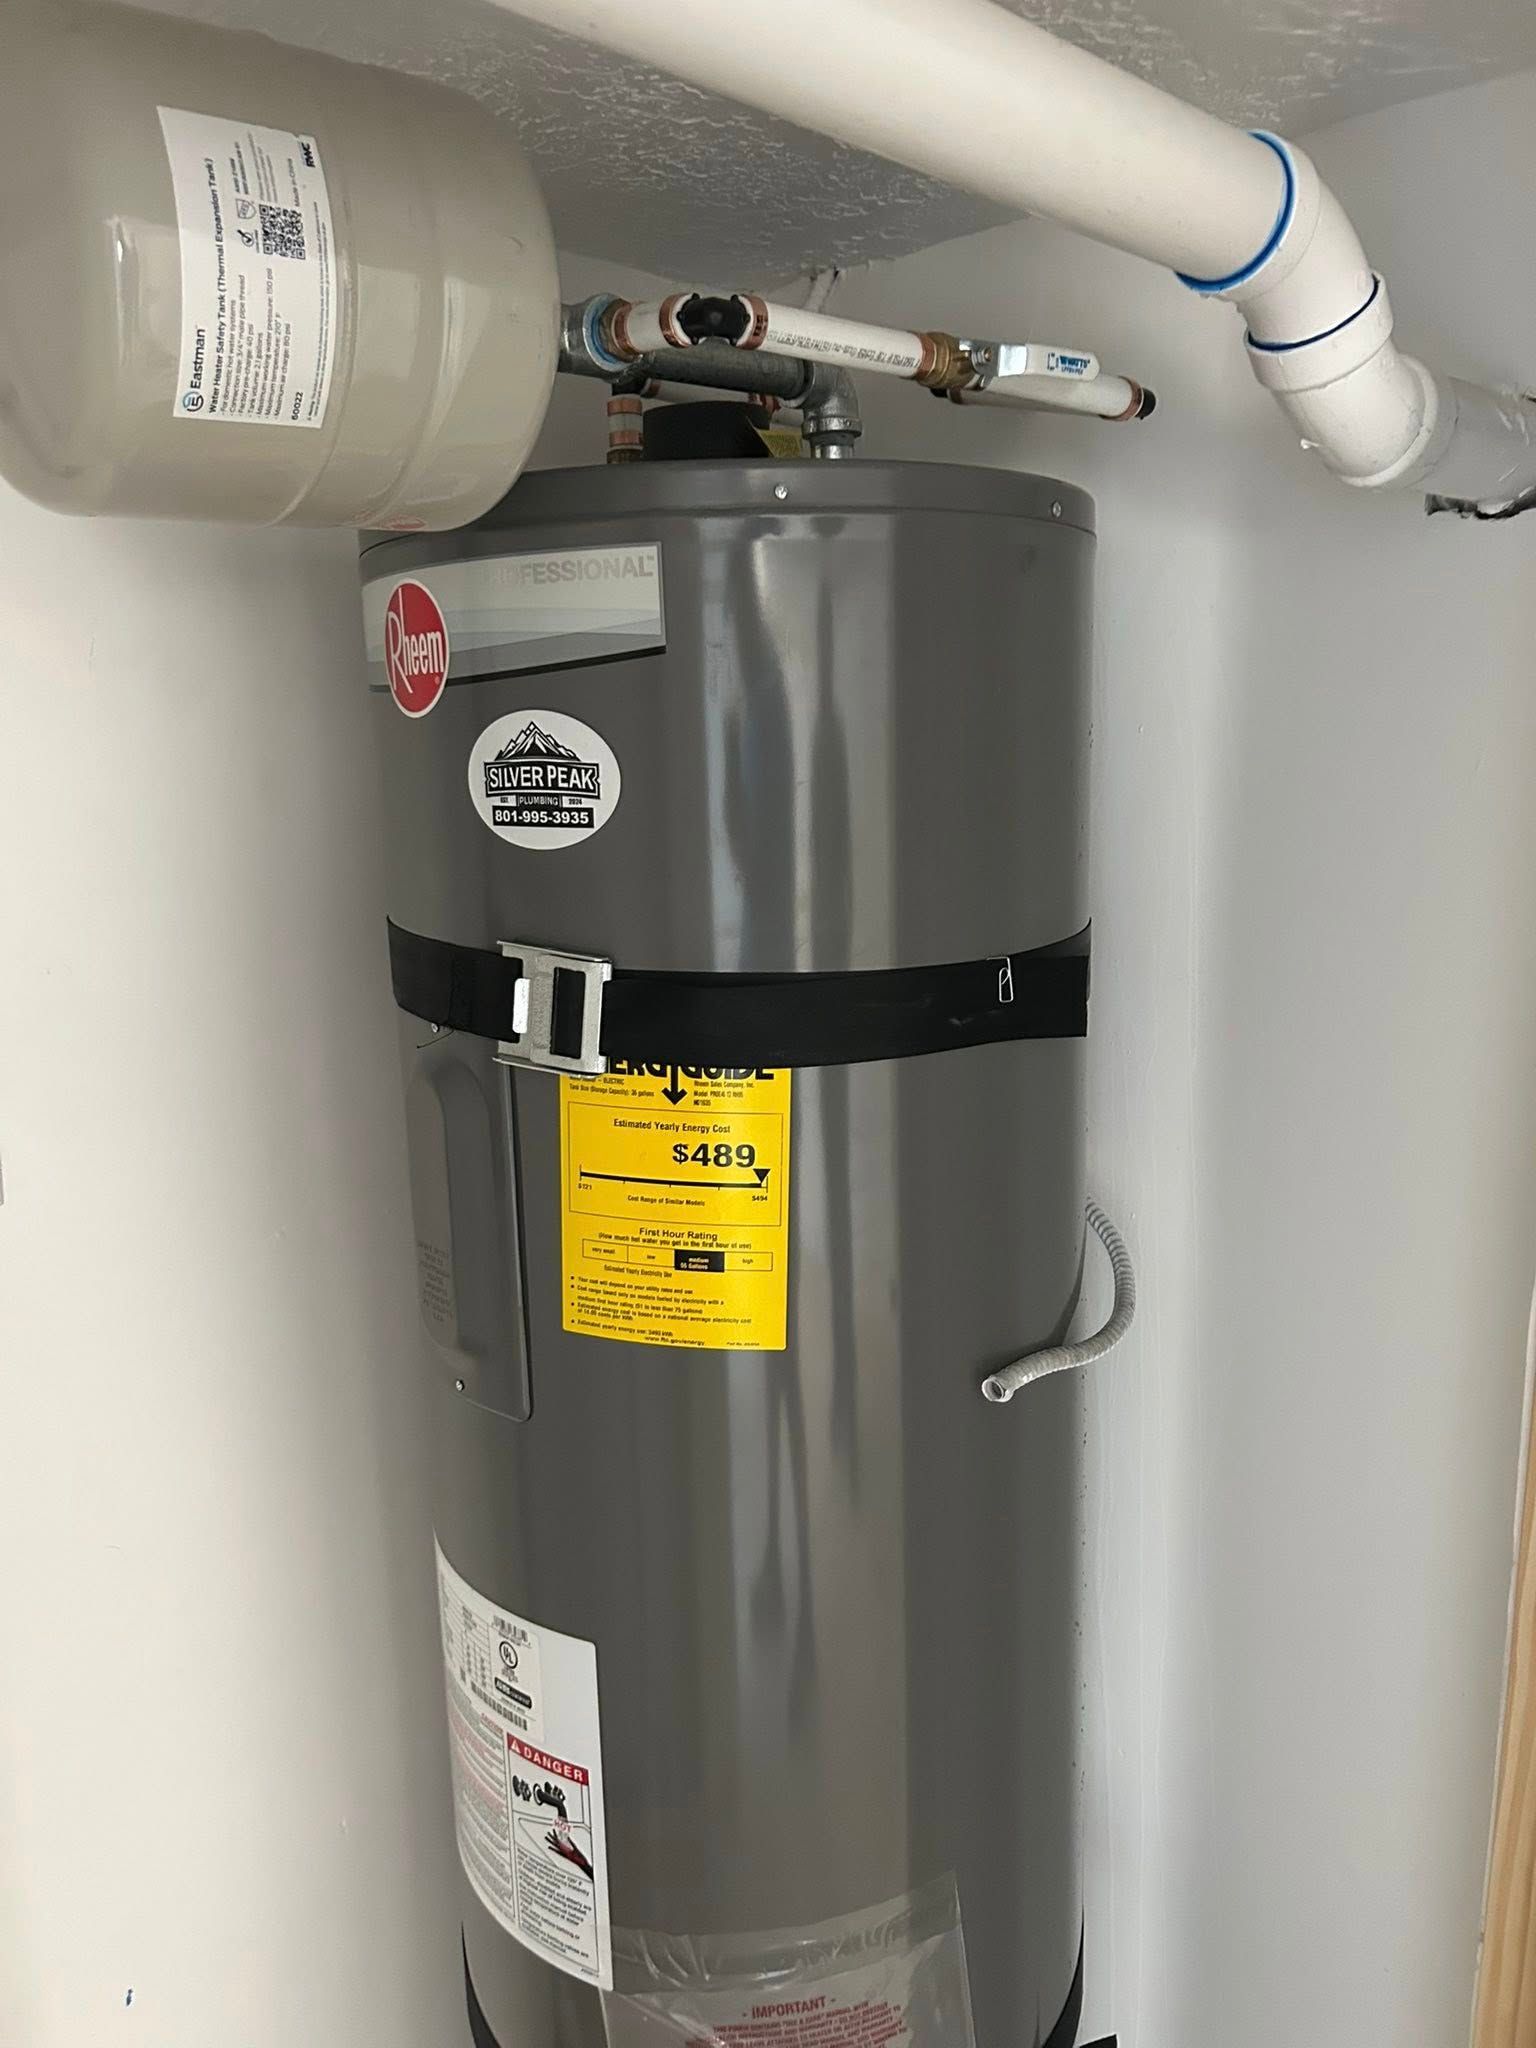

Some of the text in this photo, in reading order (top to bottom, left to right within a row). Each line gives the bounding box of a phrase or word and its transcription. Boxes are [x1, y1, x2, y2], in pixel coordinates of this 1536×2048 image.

[301, 142, 316, 168] RWC
[204, 158, 217, 187] Tank)
[287, 158, 296, 178] China
[211, 190, 223, 242] Expansion
[216, 245, 226, 307] (Thermal
[216, 321, 226, 354] Safety
[191, 329, 206, 389] Eastman
[213, 355, 223, 386] Heater
[209, 388, 220, 413] Water
[292, 392, 303, 420] 60022
[387, 588, 444, 693] Rheem
[489, 765, 594, 790] SILVER PEAK
[520, 796, 558, 806] PLUMBING
[495, 810, 589, 824] 801-995-3935
[614, 1119, 730, 1134] Estimated Yearly Energy Cost
[672, 1143, 756, 1168] $489
[640, 1196, 657, 1204] Range
[640, 1228, 718, 1241] First Hour Rating
[524, 1747, 583, 1781] DANGER
[553, 1819, 572, 1833] HOT
[751, 1996, 826, 2019] IMPORTANT
